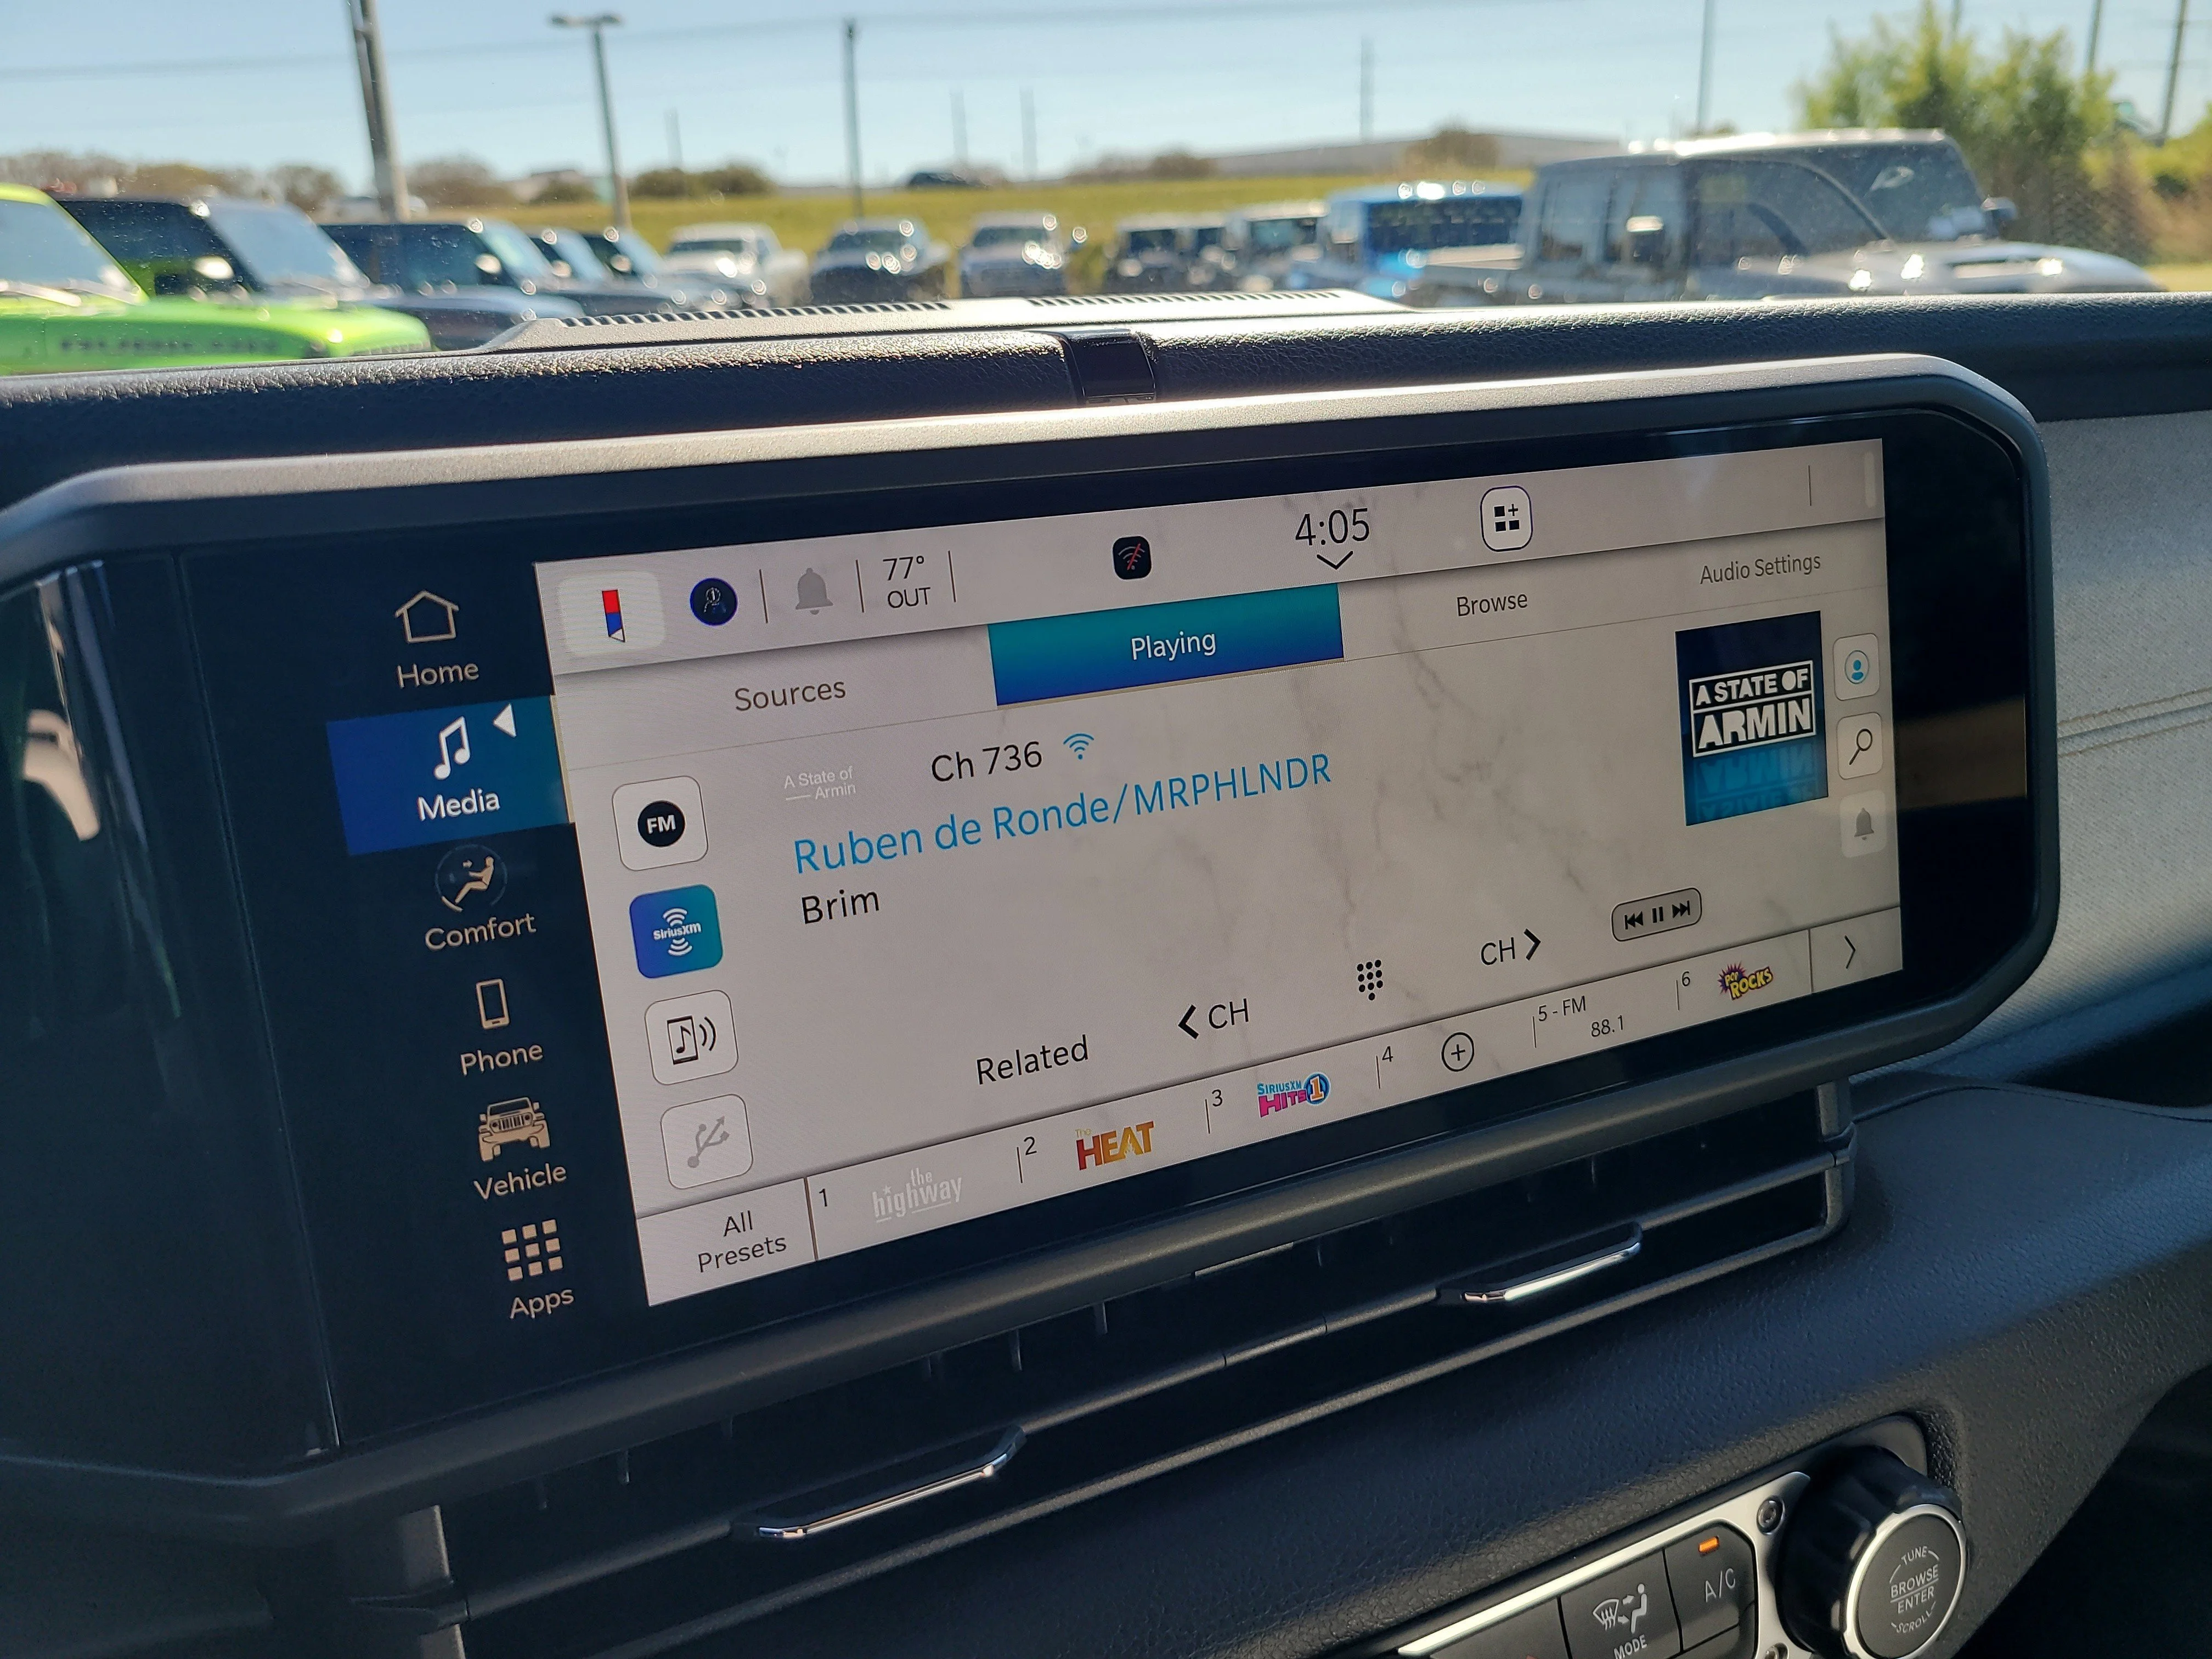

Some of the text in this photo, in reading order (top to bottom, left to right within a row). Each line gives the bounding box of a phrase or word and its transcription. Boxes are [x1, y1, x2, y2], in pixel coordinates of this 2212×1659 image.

[1295, 508, 1370, 546] 4:05
[882, 555, 925, 580] 77°
[1700, 552, 1821, 585] Audio Settings
[887, 587, 931, 609] OUT
[1457, 591, 1528, 617] Browse
[1131, 631, 1216, 661] Playing
[396, 662, 479, 689] Home
[1696, 668, 1809, 706] A STATE OF
[734, 680, 847, 712] Sources
[1698, 698, 1811, 749] ARMIN
[932, 741, 1042, 782] Ch 736
[784, 766, 854, 789] A State of
[815, 782, 856, 800] Armin
[417, 788, 501, 822] Media
[794, 753, 1331, 874] Ruben de Ronde/MRPHLNDR
[646, 814, 677, 834] FM
[802, 889, 880, 925] Brim
[425, 913, 537, 951] Comfort
[1480, 936, 1516, 967] CH
[1681, 970, 1690, 987] 6
[1729, 968, 1773, 1000] ROCKS
[1208, 998, 1250, 1030] CH
[1538, 1005, 1547, 1022] 5
[1562, 995, 1586, 1016] FM
[1591, 1014, 1624, 1037] 88.1
[460, 1043, 544, 1076] Phone
[976, 1034, 1090, 1085] Related
[1381, 1046, 1394, 1065] 4
[1212, 1089, 1223, 1107] 3
[1258, 1089, 1307, 1118] HITS
[1024, 1136, 1037, 1155] 2
[1076, 1121, 1154, 1171] HEAT
[473, 1163, 567, 1200] Vehicle
[911, 1167, 933, 1187] the
[818, 1188, 828, 1207] 1
[872, 1177, 962, 1218] highway
[723, 1210, 754, 1237] All
[697, 1237, 787, 1273] Presets
[510, 1288, 574, 1319] Apps
[1901, 1545, 1928, 1565] TUNE
[1705, 1568, 1736, 1603] A/C
[1891, 1564, 1939, 1599] BROWSE
[1898, 1585, 1934, 1614] ENTER
[1896, 1610, 1933, 1634] SCROLL
[1613, 1634, 1647, 1659] MODE
